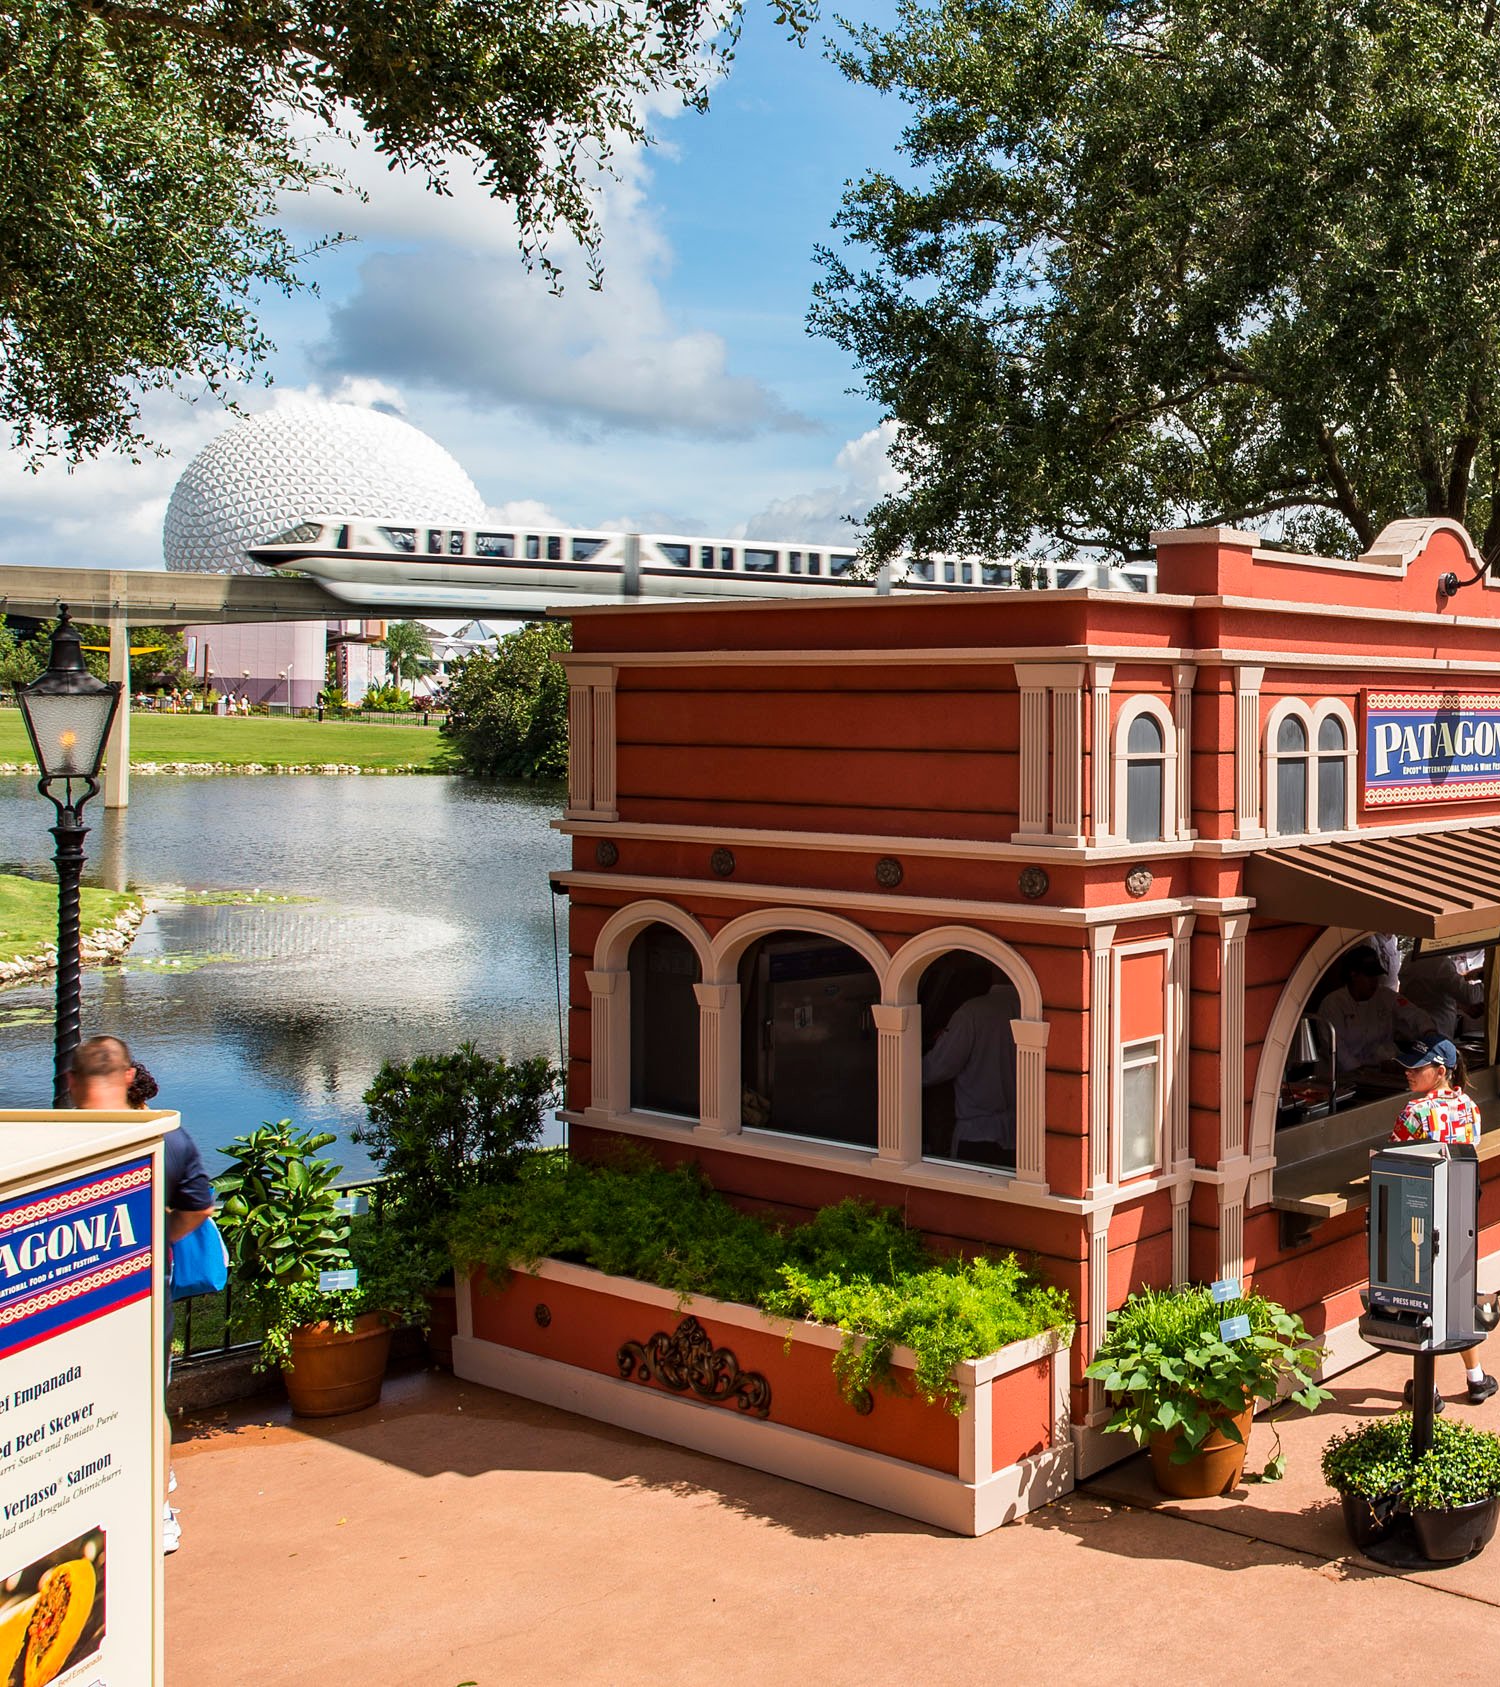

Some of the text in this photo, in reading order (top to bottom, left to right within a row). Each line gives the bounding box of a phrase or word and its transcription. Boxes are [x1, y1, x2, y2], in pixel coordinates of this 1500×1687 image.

[1423, 765, 1460, 774] INTERNATIONAL
[1461, 764, 1474, 772] FOOD
[1480, 763, 1492, 771] WINE
[29, 1273, 47, 1287] FOOD
[48, 1271, 54, 1279] &
[55, 1265, 72, 1277] WINE
[73, 1254, 100, 1270] FESTIVAL
[1392, 1296, 1409, 1306] PRESS
[1410, 1300, 1422, 1308] HERE
[14, 1365, 82, 1408] Empanada
[16, 1423, 46, 1453] Beef
[49, 1402, 95, 1436] Skewer
[18, 1447, 44, 1468] Sauce
[45, 1439, 61, 1455] and
[63, 1423, 95, 1447] Boniato
[66, 1452, 112, 1488] Salmon
[18, 1511, 36, 1530] and
[37, 1495, 71, 1520] Arugula
[72, 1464, 123, 1501] Chimichurri
